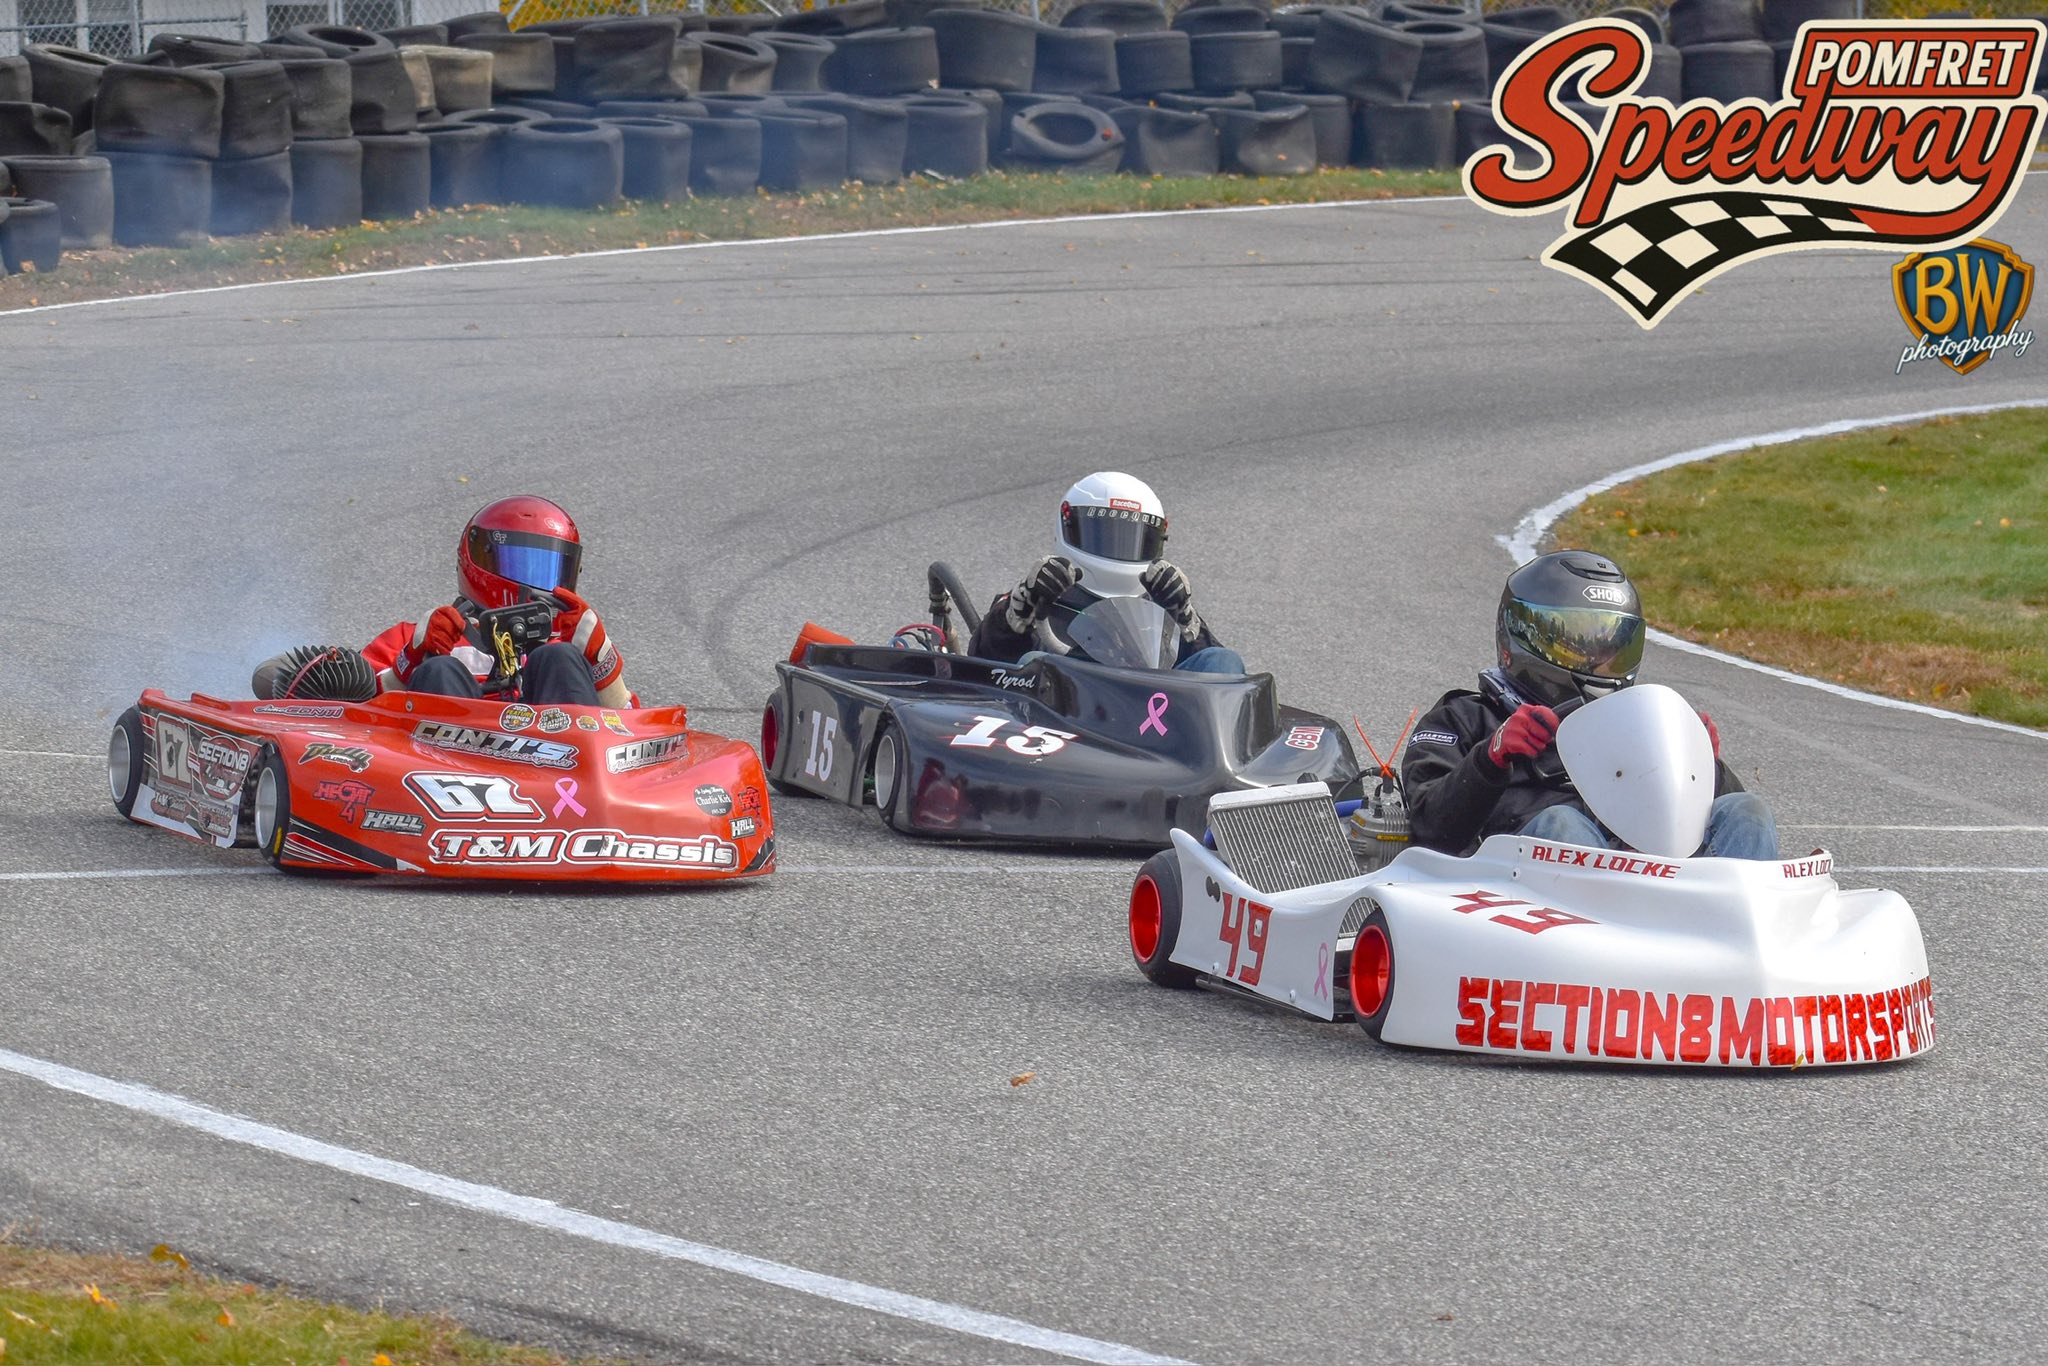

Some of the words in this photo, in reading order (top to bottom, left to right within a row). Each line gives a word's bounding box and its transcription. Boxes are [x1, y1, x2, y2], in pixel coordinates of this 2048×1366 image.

[991, 668, 1036, 689] Tyrod
[804, 710, 838, 782] 15
[950, 714, 1078, 756] 15
[410, 772, 541, 816] 67
[695, 794, 719, 806] Charlie
[718, 793, 732, 804] Kirk
[362, 811, 423, 829] HALL
[440, 833, 554, 860] T&M
[570, 831, 735, 866] Chassis
[1531, 844, 1586, 867] ALEX
[1593, 853, 1682, 880] LOCKE
[1782, 860, 1814, 879] ALEX
[1219, 891, 1274, 987] 49
